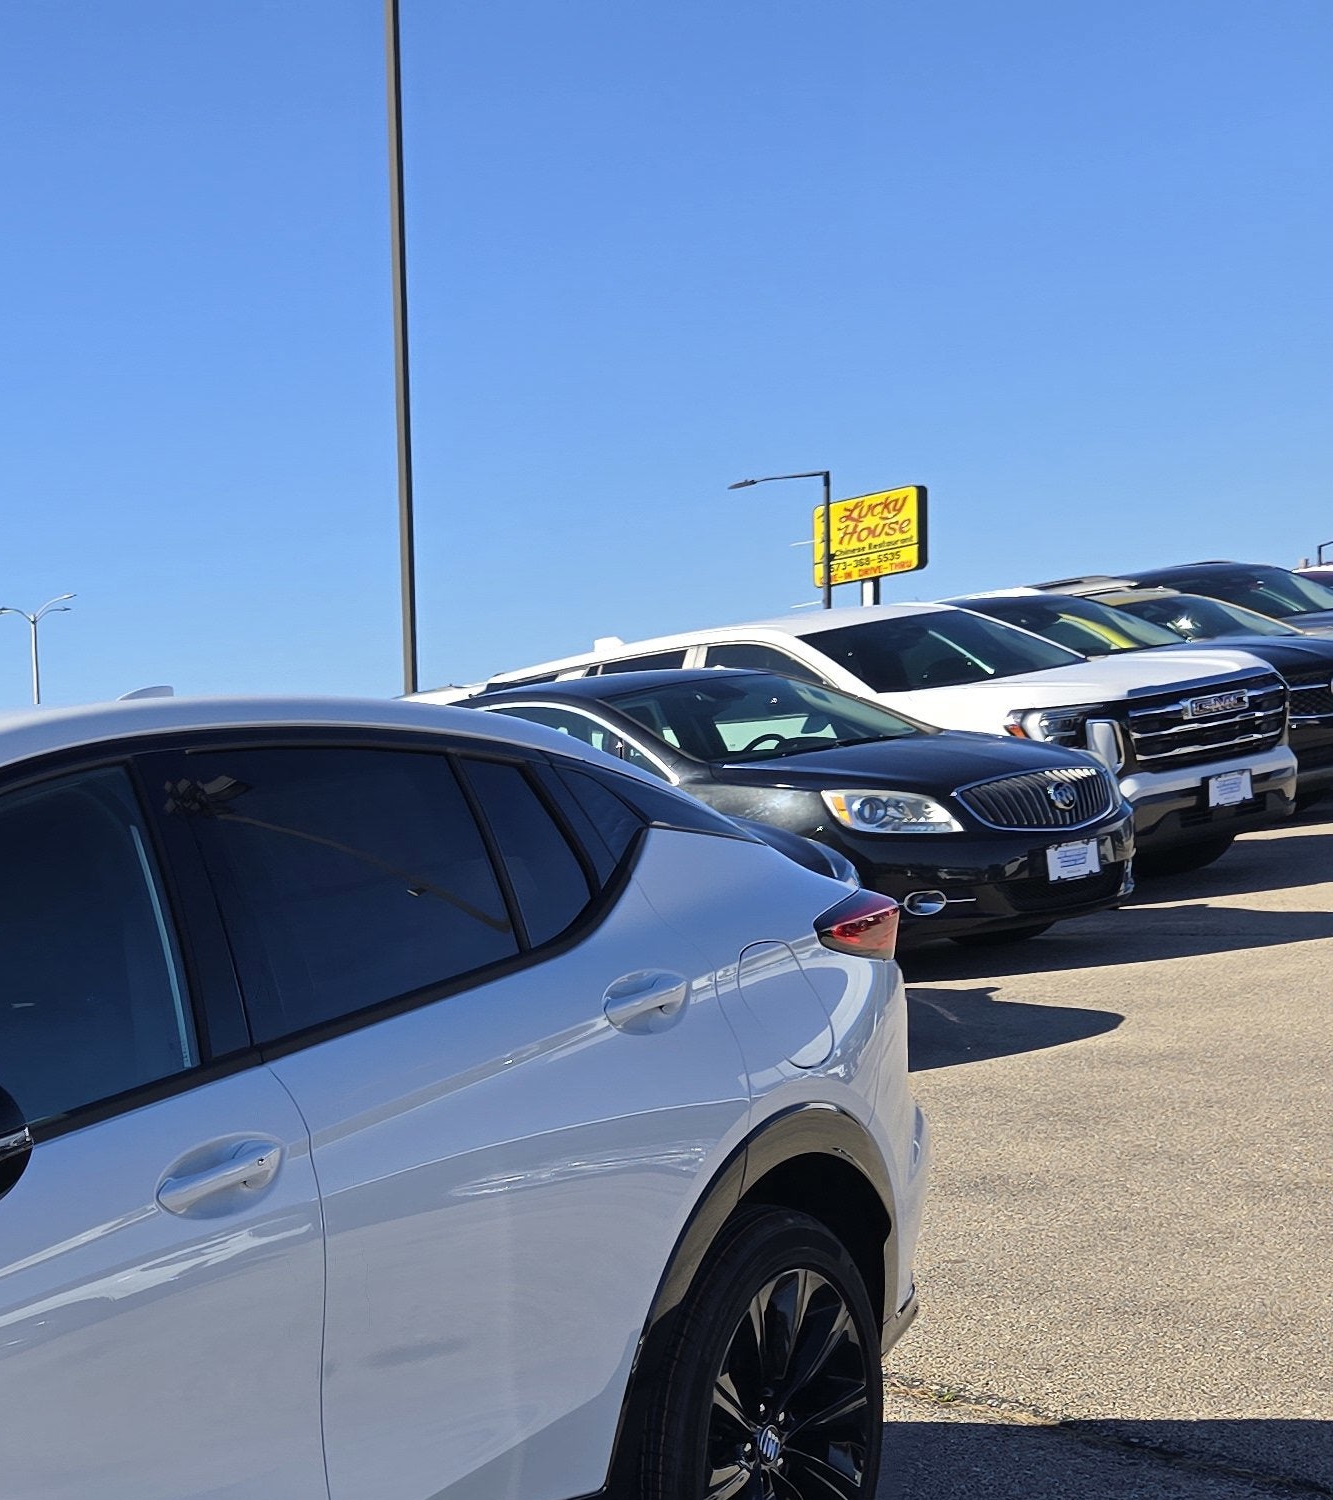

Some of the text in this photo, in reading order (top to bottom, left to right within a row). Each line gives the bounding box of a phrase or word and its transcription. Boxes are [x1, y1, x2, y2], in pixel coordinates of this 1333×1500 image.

[839, 495, 909, 522] Lucky
[837, 518, 912, 545] House
[835, 535, 914, 557] Chinese Restaurant
[1193, 692, 1247, 715] GMC
